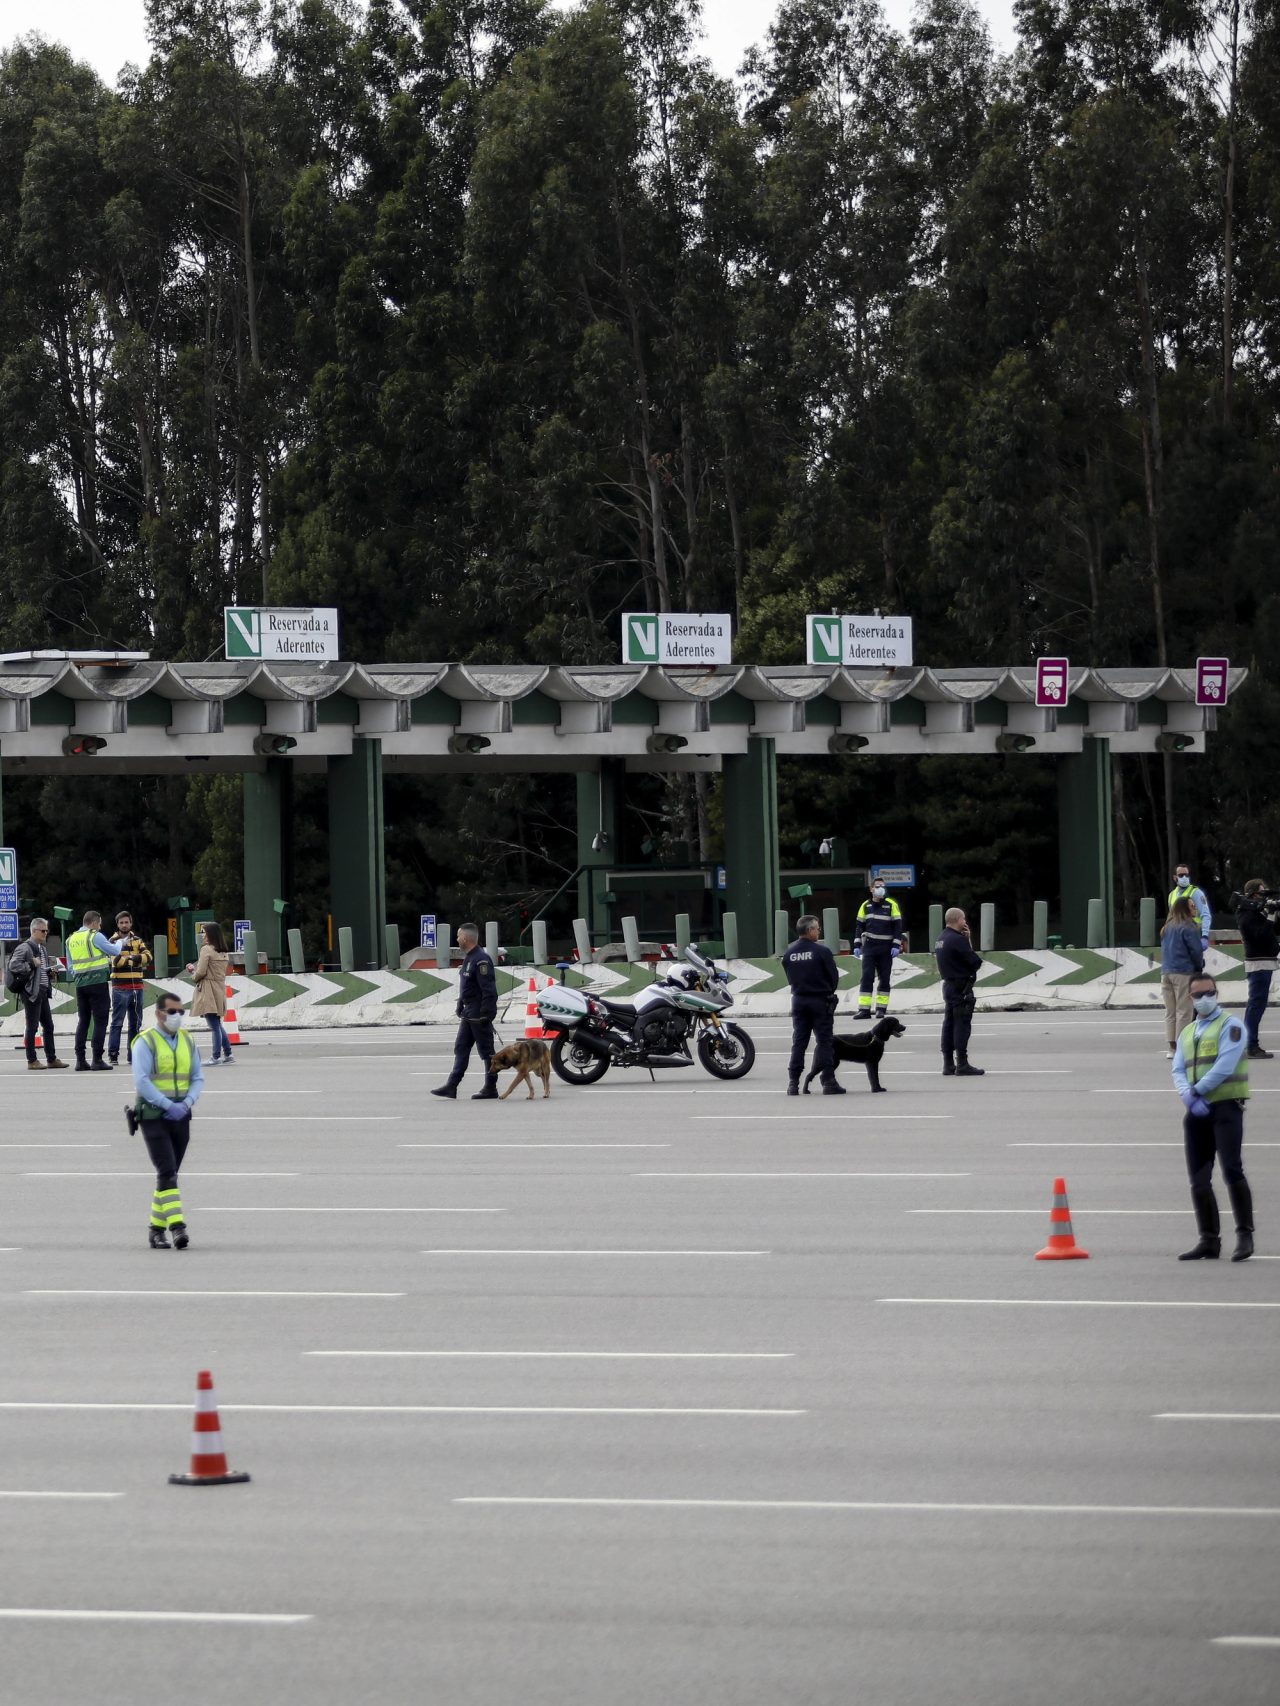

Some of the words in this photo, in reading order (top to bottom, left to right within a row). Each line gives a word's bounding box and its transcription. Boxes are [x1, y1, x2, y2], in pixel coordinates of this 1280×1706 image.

[269, 615, 320, 631] Reservada
[323, 619, 329, 631] a
[665, 621, 715, 636] Reservada
[717, 626, 723, 636] a
[849, 623, 896, 638] Reservada
[899, 628, 904, 638] a
[276, 638, 325, 653] Aderentes
[666, 641, 715, 657] Aderentes
[849, 644, 896, 658] Aderentes
[790, 952, 812, 961] GNR
